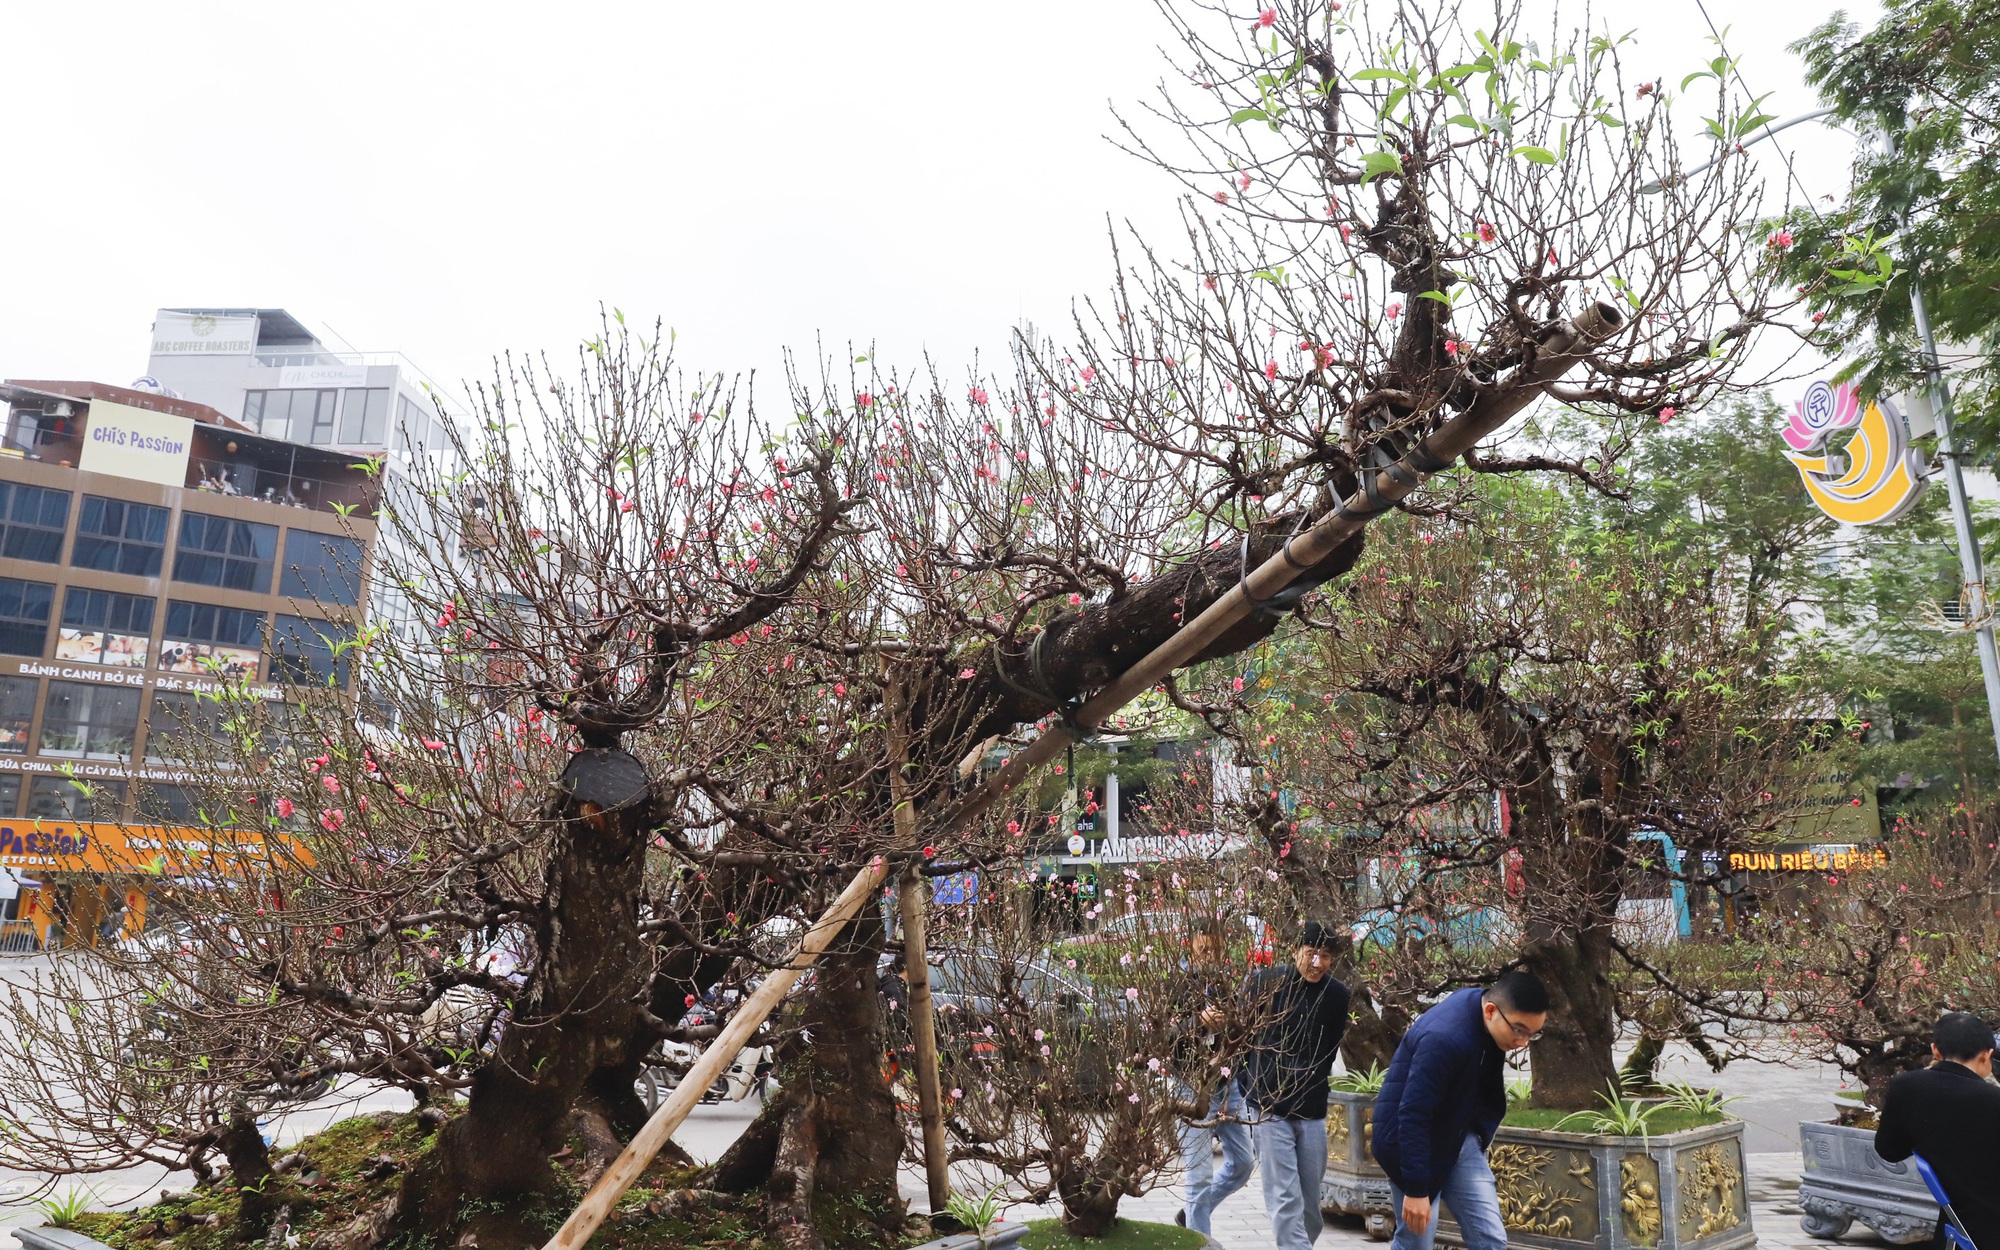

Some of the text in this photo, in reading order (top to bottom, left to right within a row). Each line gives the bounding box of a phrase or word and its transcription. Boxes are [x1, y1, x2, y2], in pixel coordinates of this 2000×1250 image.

[153, 340, 250, 352] ABC COFFEE ROASTERS
[19, 662, 60, 676] BÁNH
[62, 668, 102, 680] CANH
[22, 762, 52, 772] CHUA
[85, 766, 108, 776] CÂY
[1077, 819, 1094, 831] aha
